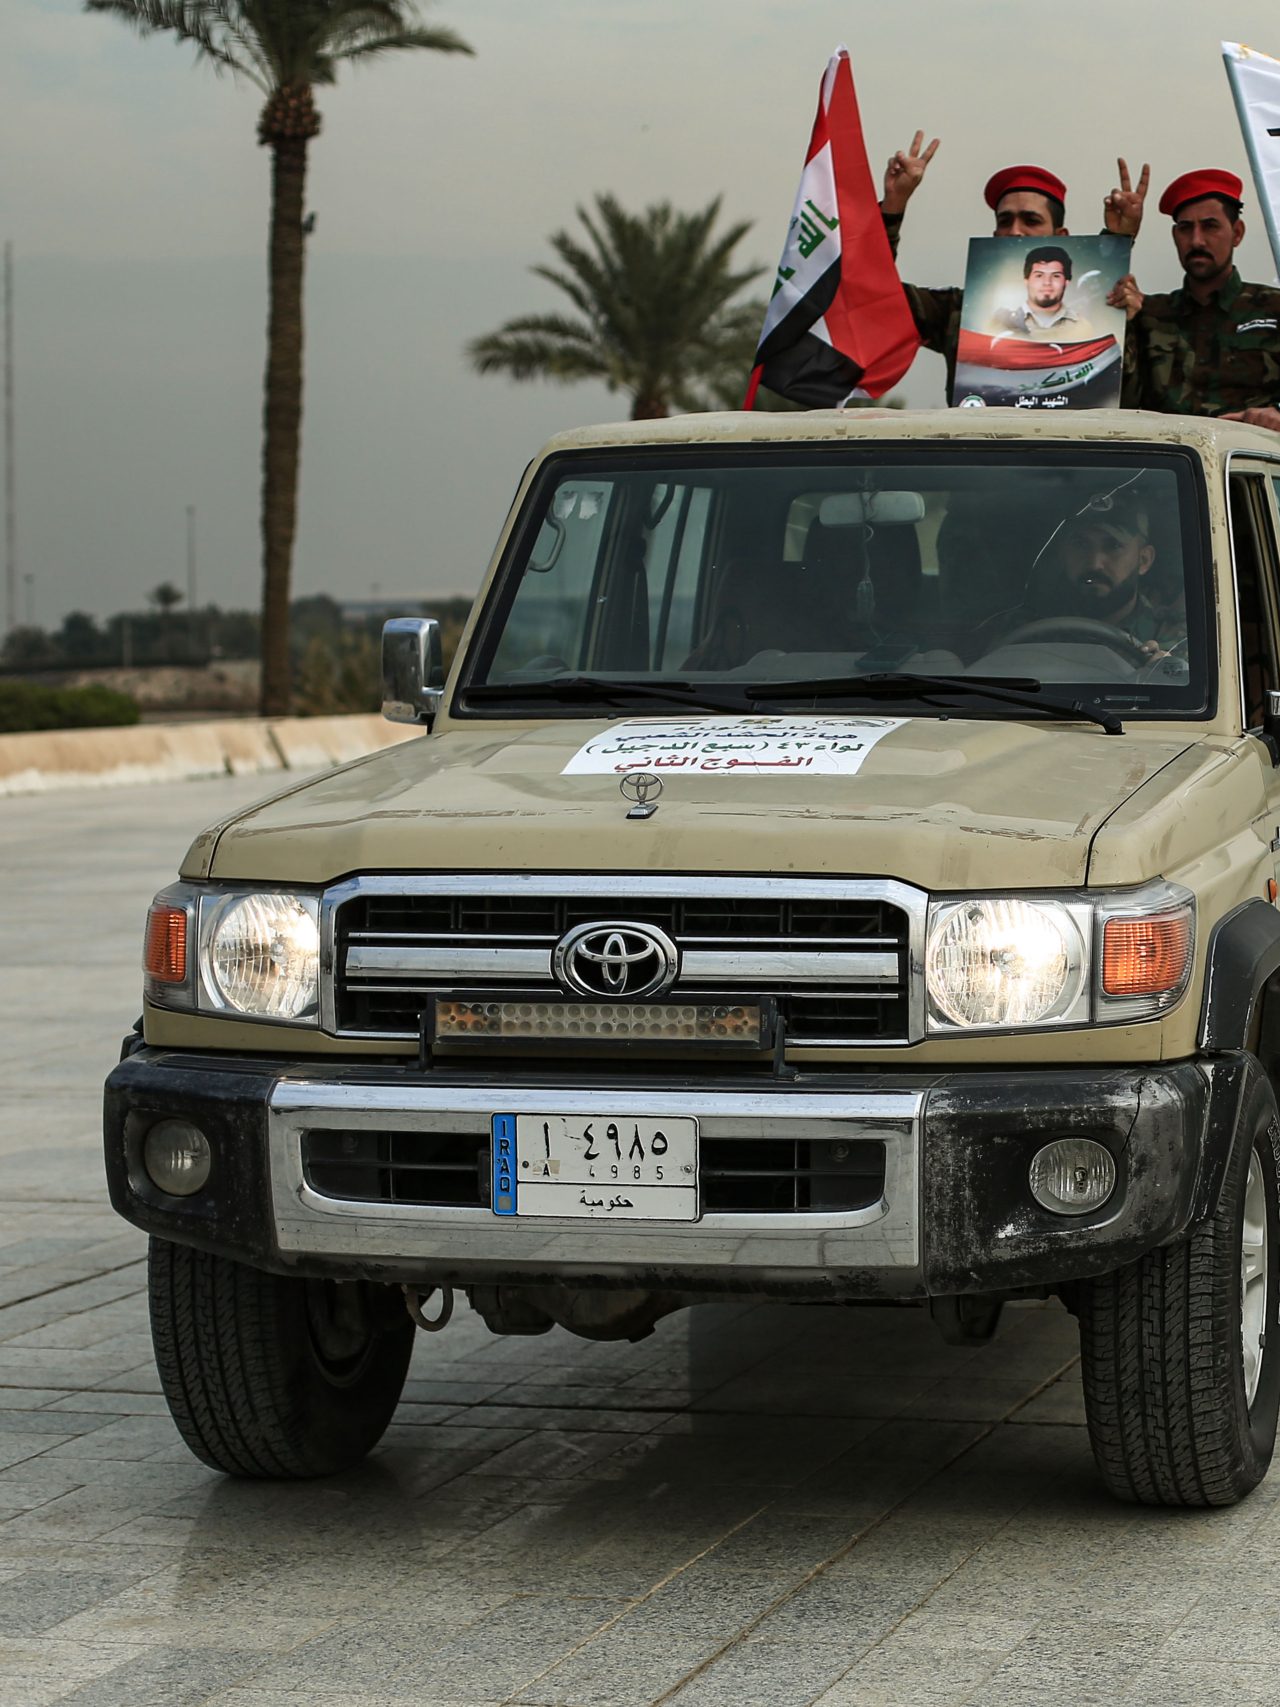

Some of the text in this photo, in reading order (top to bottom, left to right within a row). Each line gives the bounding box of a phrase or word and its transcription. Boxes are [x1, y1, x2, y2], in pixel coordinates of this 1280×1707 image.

[1014, 395, 1069, 409] الشهيد البطل
[615, 731, 712, 742] الشعبي
[715, 731, 798, 739] الحشد
[776, 742, 810, 752] ٤٣
[814, 741, 865, 753] لواء
[613, 755, 699, 772] الثاني
[582, 1122, 668, 1161] ٤٩٨٥
[499, 1119, 512, 1193] IRAQ
[541, 1163, 551, 1177] A
[579, 1189, 634, 1216] حكومية
